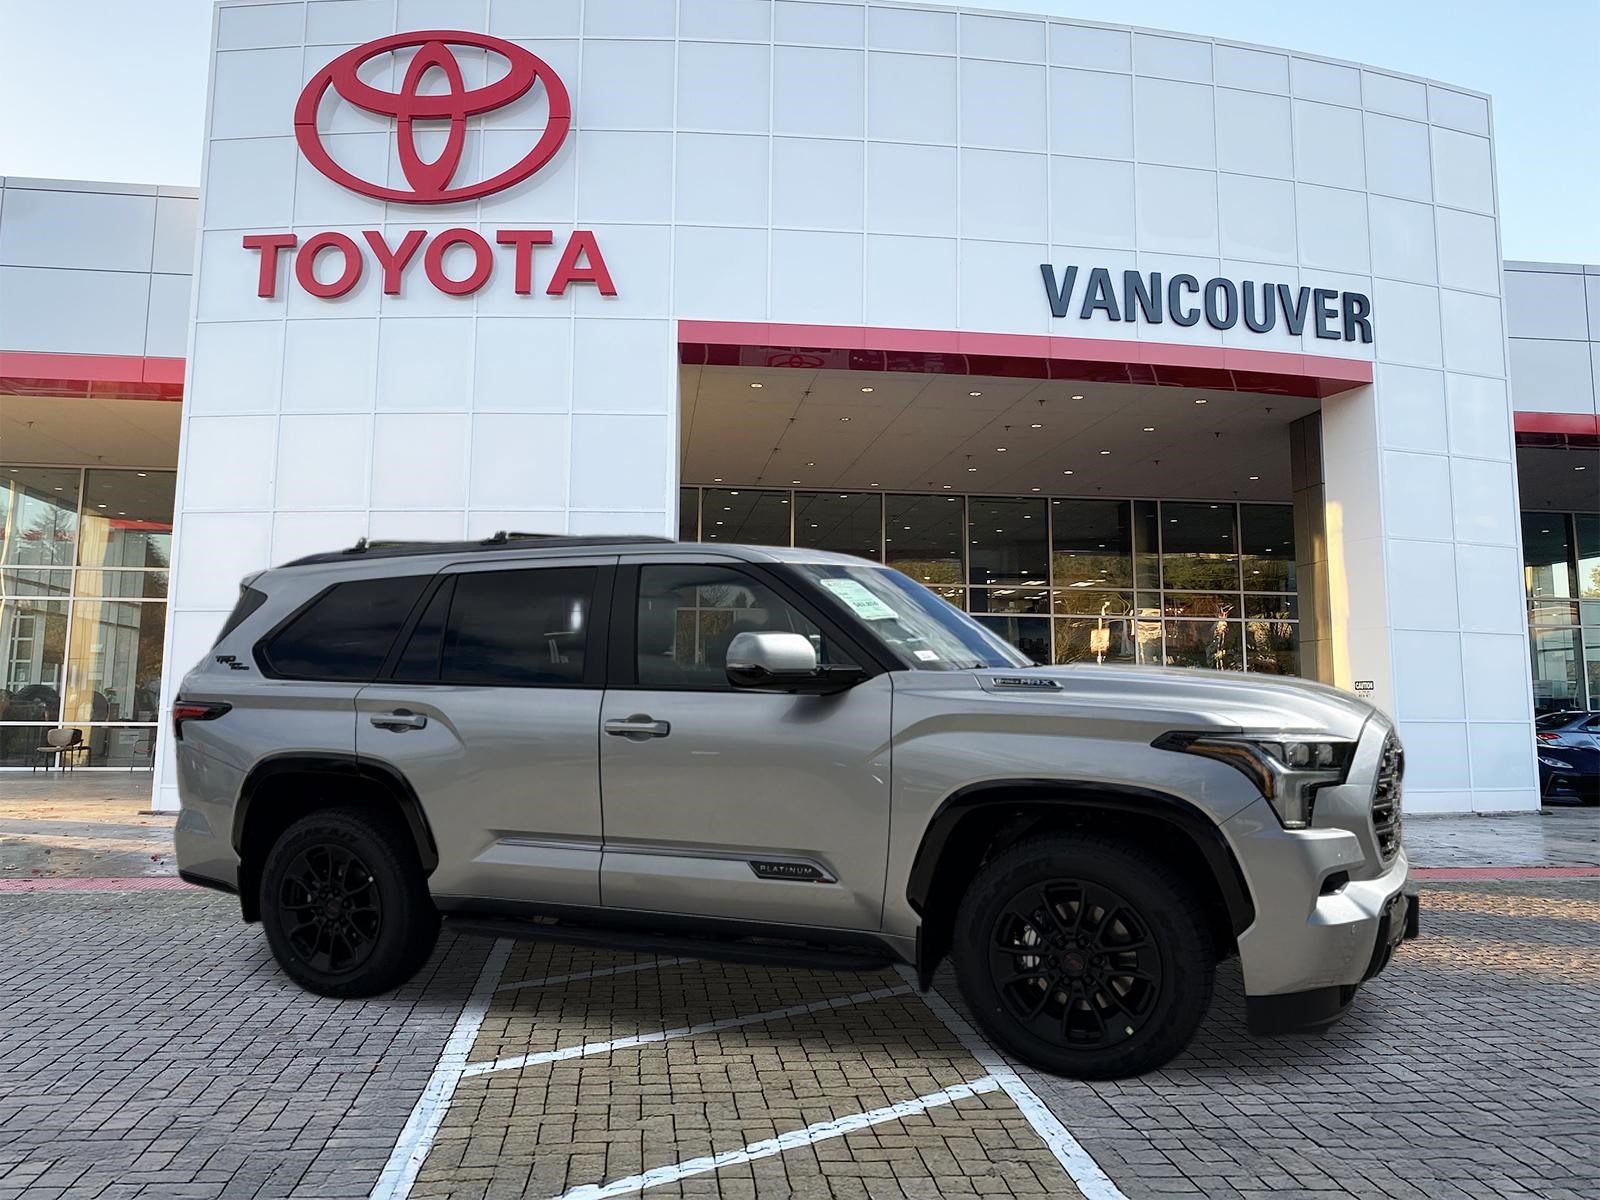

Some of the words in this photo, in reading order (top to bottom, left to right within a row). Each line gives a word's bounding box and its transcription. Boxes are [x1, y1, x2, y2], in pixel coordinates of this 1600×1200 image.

[243, 227, 618, 299] TOYOTA
[1040, 263, 1374, 344] VANCOUVER
[760, 864, 813, 874] PLATINUM
